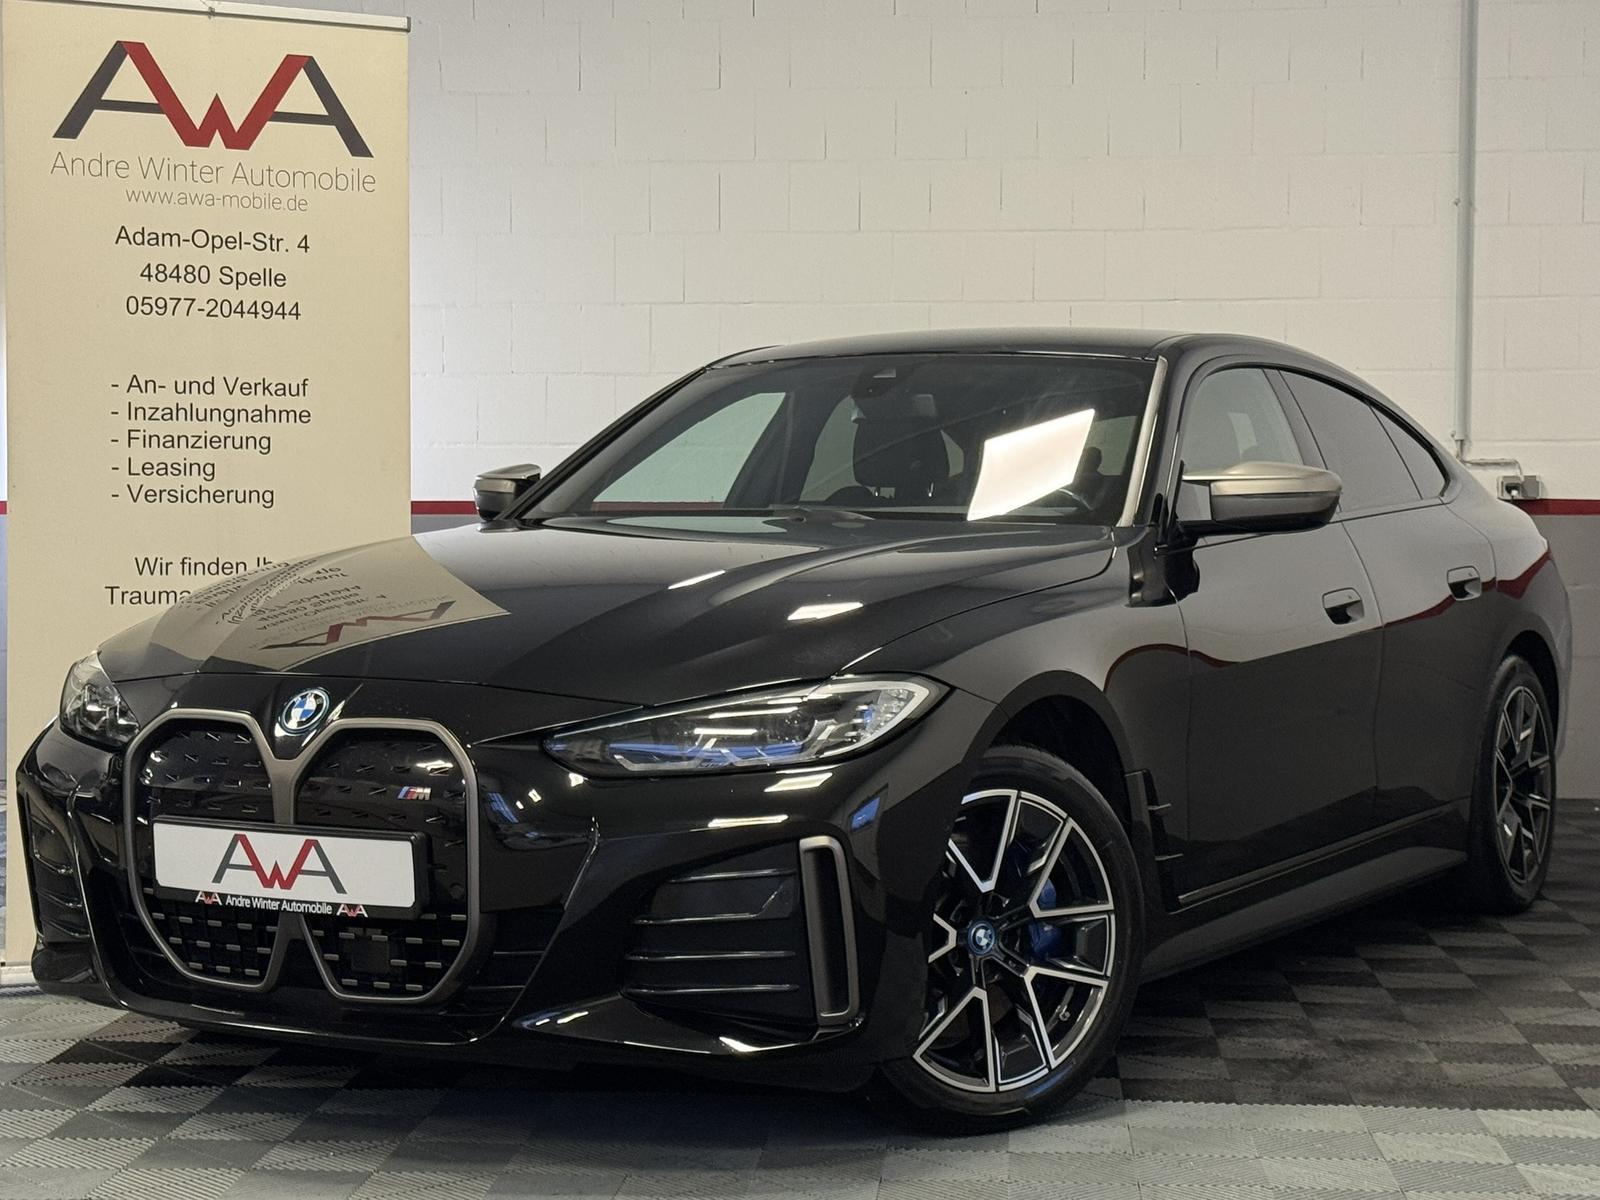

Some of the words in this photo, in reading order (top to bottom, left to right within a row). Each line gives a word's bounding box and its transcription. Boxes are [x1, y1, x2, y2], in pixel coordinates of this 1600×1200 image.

[51, 152, 130, 179] Andre
[138, 156, 225, 184] Winter
[232, 162, 376, 192] Automobile
[126, 189, 308, 212] www.awa-mobile.de
[115, 225, 290, 254] Adam-Opel-Str.
[296, 234, 311, 253] 4
[140, 263, 211, 284] 48480
[219, 265, 287, 290] Spelle
[126, 296, 302, 320] 05977-2044944
[126, 374, 166, 394] An-
[174, 376, 216, 395] und
[223, 376, 310, 397] Verkauf
[127, 402, 312, 427] Inzahlungnahme
[127, 429, 272, 455] Finanzierung
[127, 457, 216, 482] Leasing
[127, 484, 275, 509] Versicherung
[134, 556, 174, 576] Wir
[180, 556, 248, 576] finden
[225, 894, 251, 908] Andre
[251, 897, 280, 911] Winter
[281, 899, 333, 914] Automobile
